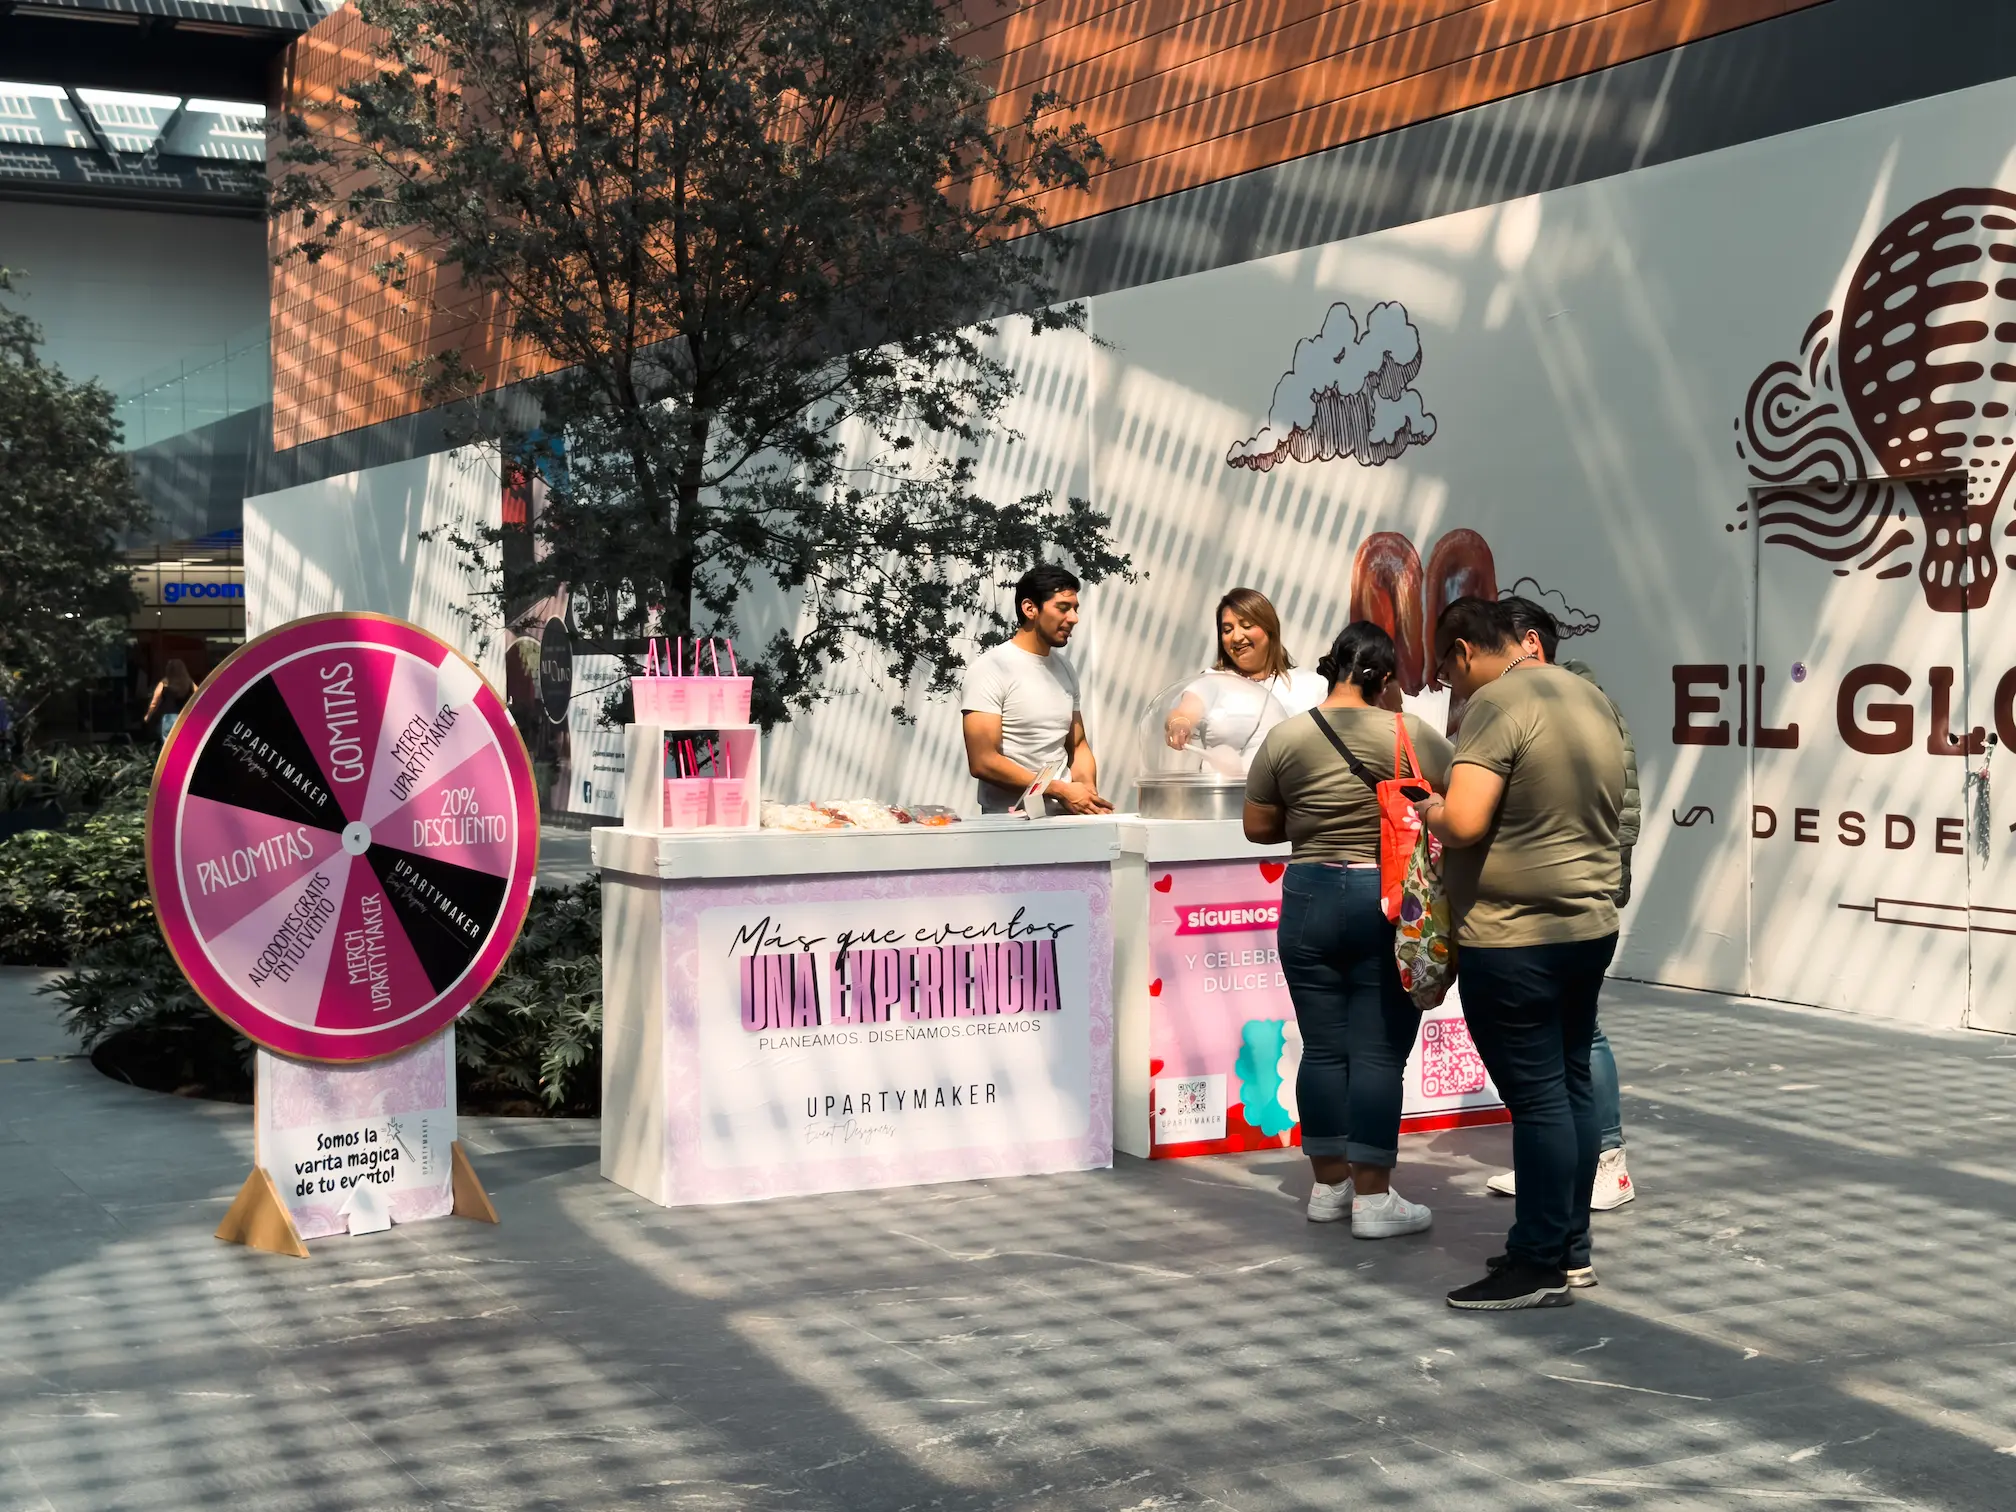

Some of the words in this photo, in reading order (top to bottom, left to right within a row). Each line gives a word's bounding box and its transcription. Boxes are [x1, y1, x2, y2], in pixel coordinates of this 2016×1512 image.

[320, 662, 364, 783] GOMITAS
[1672, 664, 1799, 749] EL
[1836, 663, 2016, 756] GL
[233, 721, 328, 807] UPARTYMAKER
[390, 704, 459, 801] UPARTYMAKER
[391, 713, 429, 765] MERCH
[441, 787, 479, 816] 20%
[413, 815, 507, 848] DESCUENTO
[1752, 804, 1965, 855] DESDE
[197, 827, 315, 896] PALOMITAS
[296, 898, 335, 949] EVENTO
[395, 859, 480, 939] UPARTYMAKER
[1187, 907, 1279, 928] SÍGUENOS
[248, 912, 304, 988] ALGODONES
[294, 872, 331, 918] GRATIS
[283, 942, 305, 966] TU
[361, 892, 392, 1012] UPARTYMAKER
[728, 915, 827, 958] Más
[835, 929, 906, 971] que
[914, 906, 1075, 944] eventos
[273, 960, 295, 983] EN
[344, 929, 369, 985] MERCH
[1185, 954, 1198, 970] Y
[1203, 972, 1268, 993] DULCE
[740, 951, 823, 1032] UNA
[829, 938, 1062, 1028] EXPERIENCIA
[758, 1032, 863, 1051] PLANEAMOS.
[807, 1083, 996, 1118] UPARTYMAKER
[1161, 1115, 1221, 1128] UPARTYMAKER
[295, 1154, 343, 1175] varita
[347, 1146, 399, 1170] mágica
[317, 1131, 360, 1151] Somos
[364, 1127, 377, 1144] la
[296, 1178, 314, 1197] de
[318, 1176, 335, 1193] tu
